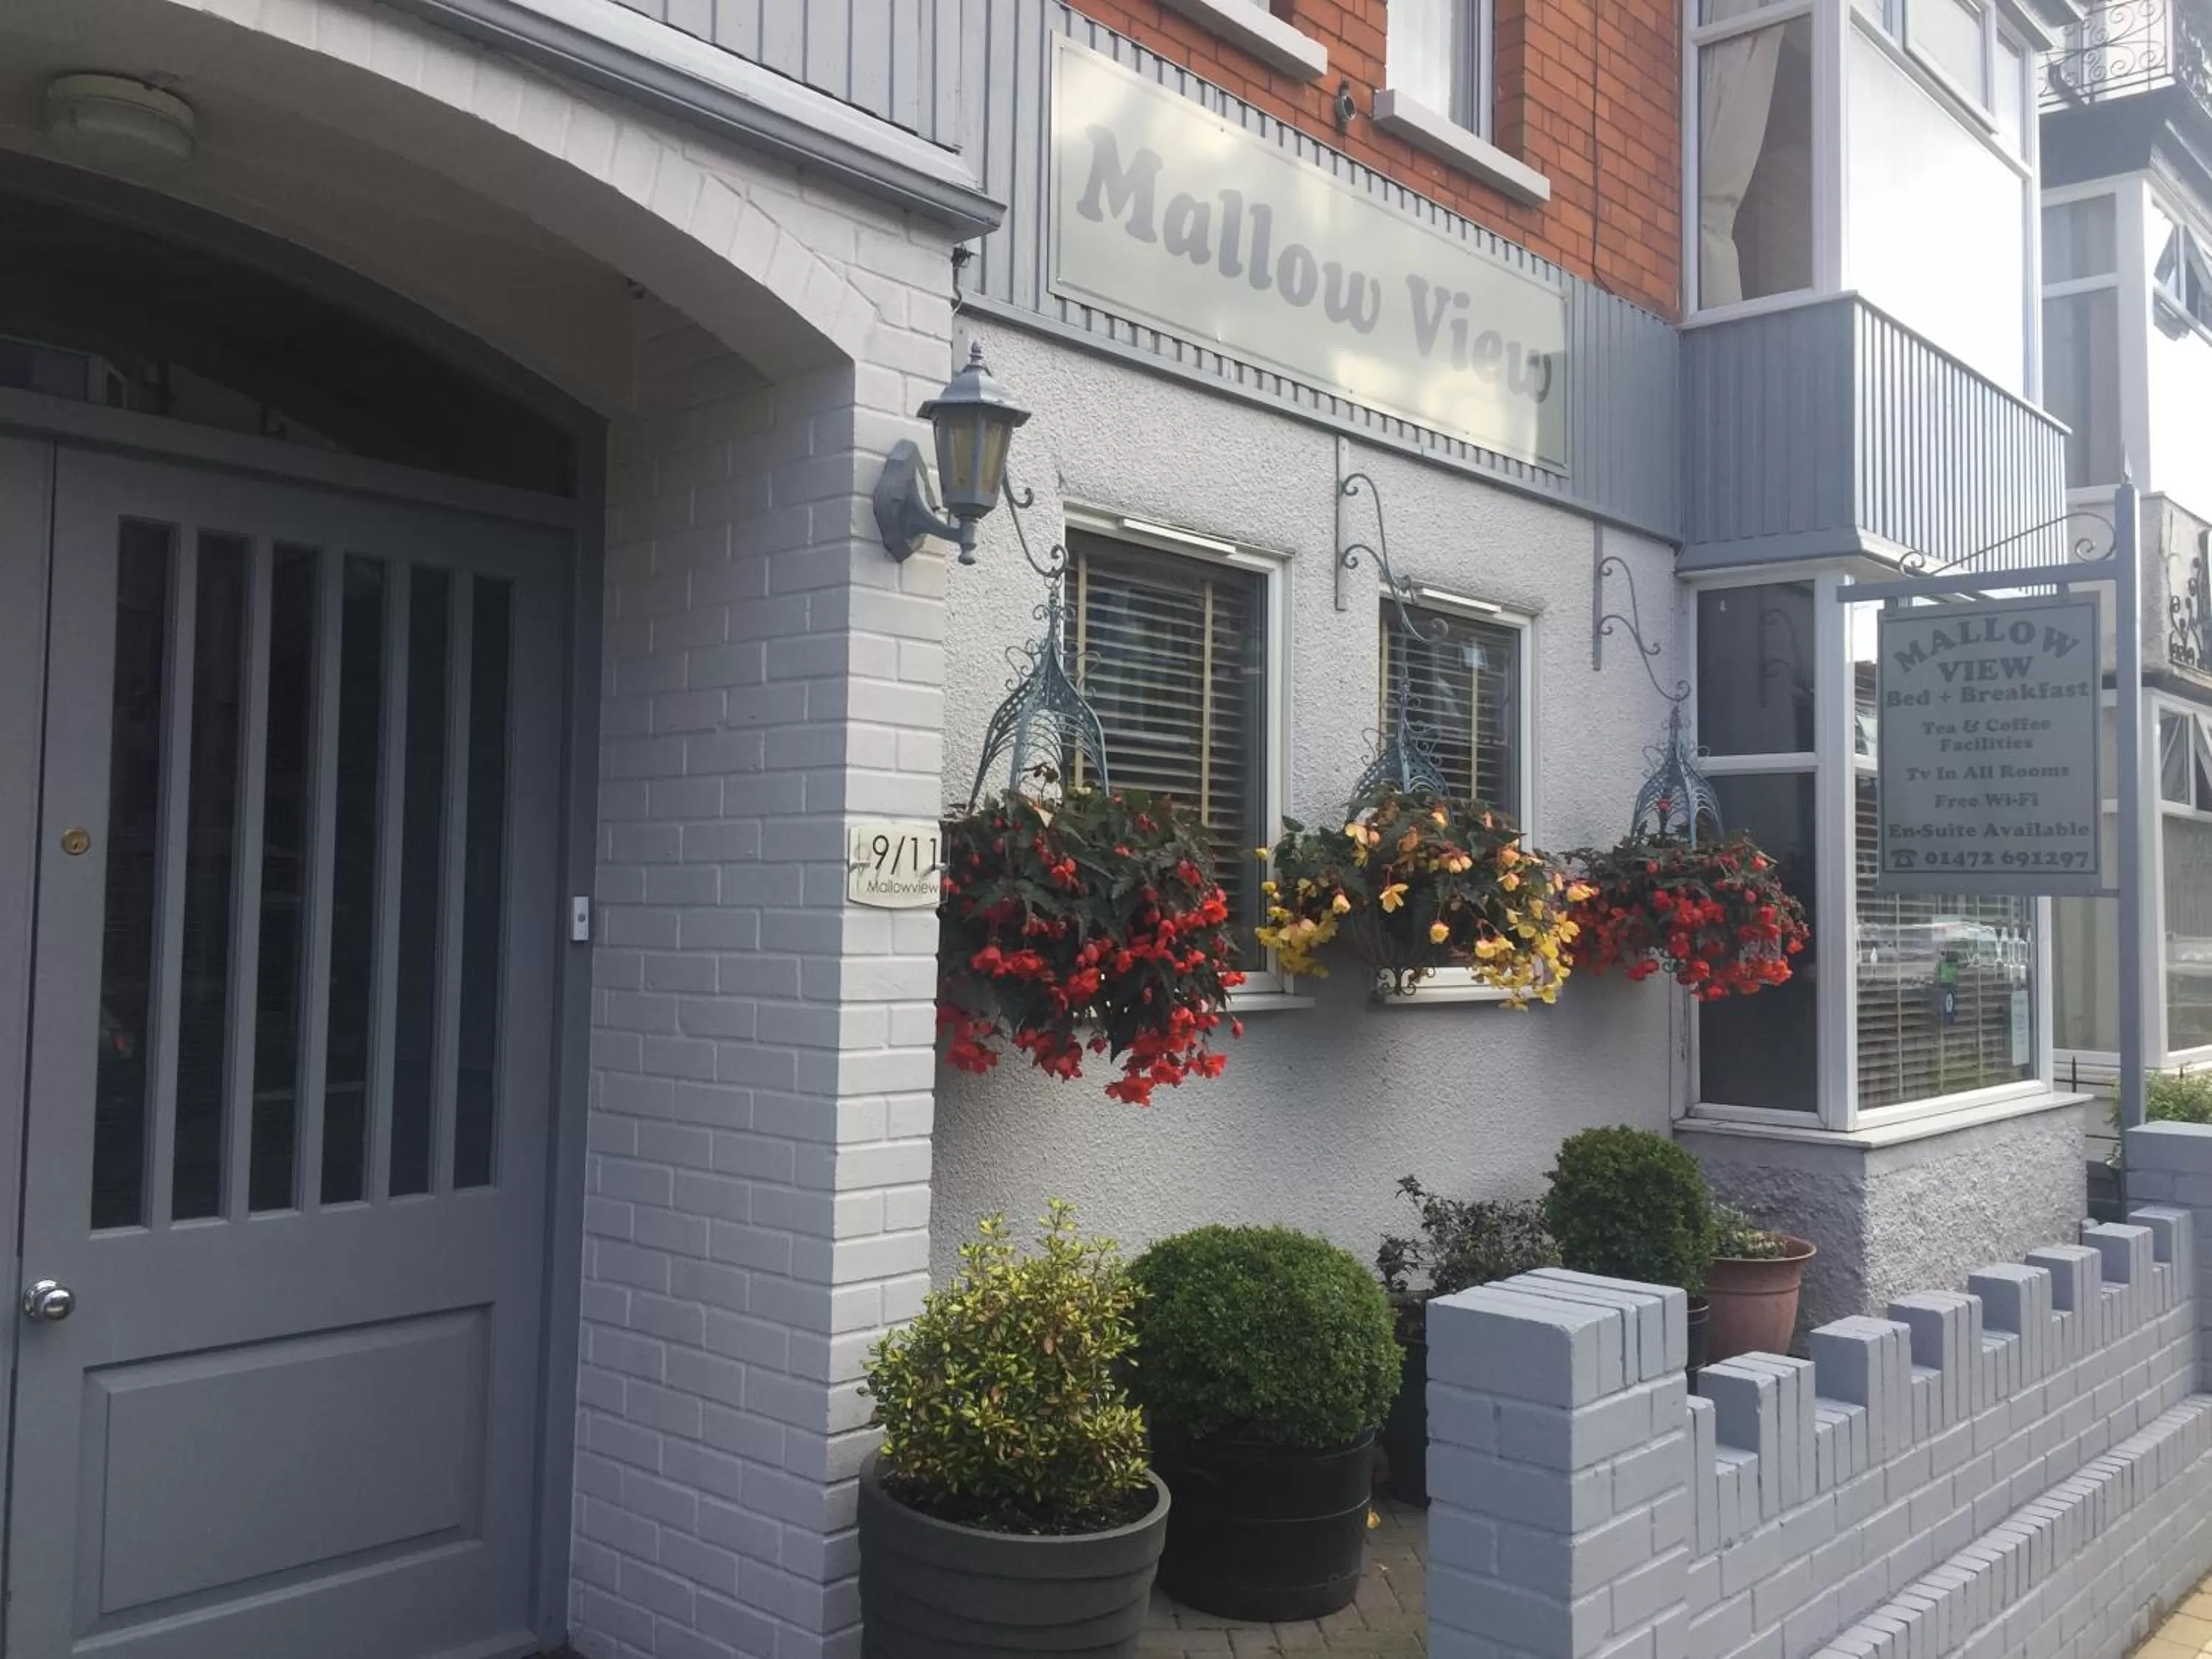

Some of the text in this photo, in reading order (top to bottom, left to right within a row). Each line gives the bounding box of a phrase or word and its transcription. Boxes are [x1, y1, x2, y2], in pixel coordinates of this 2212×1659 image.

[1077, 124, 1551, 403] Mallow View
[1893, 618, 2080, 672] MALLOW
[1937, 655, 2034, 682] VIEW
[1886, 689, 1930, 707] Bed
[1959, 681, 2090, 704] Breakfast
[1923, 717, 2052, 735] Tea & Coffee
[1905, 765, 2070, 782] Tv In All Rooms
[1934, 792, 2039, 808] Free Wi-Fi
[1888, 822, 2089, 838] En-Suite Available
[872, 835, 936, 875] 9/11
[1924, 849, 2089, 868] 01472 691297
